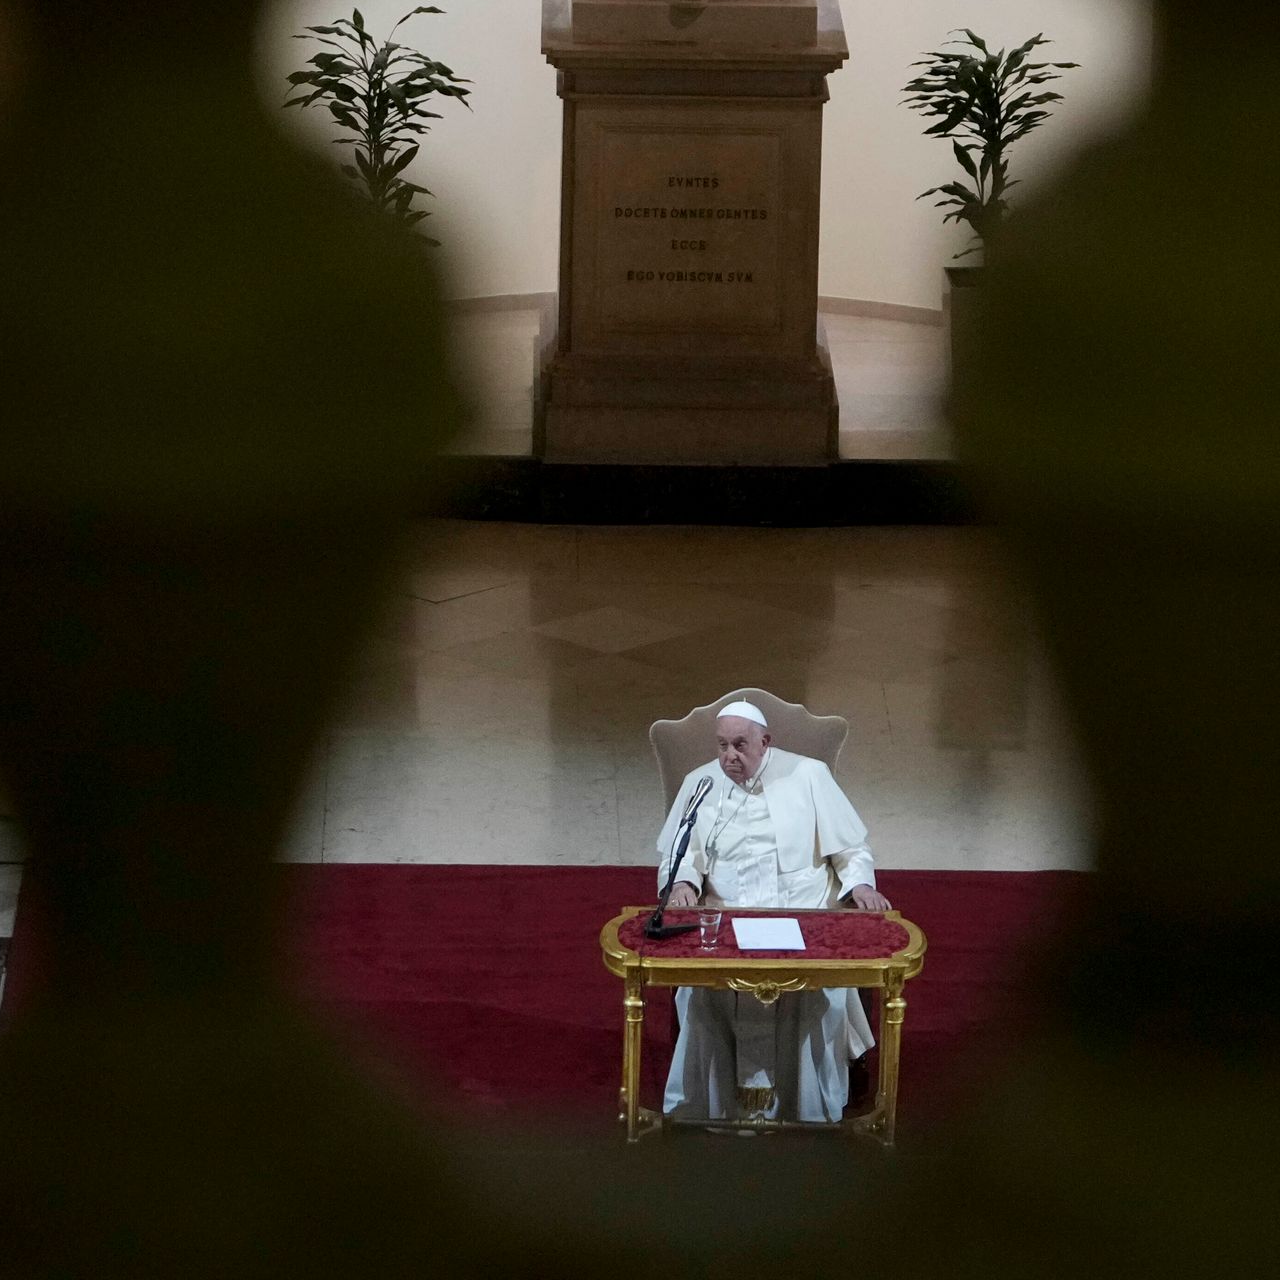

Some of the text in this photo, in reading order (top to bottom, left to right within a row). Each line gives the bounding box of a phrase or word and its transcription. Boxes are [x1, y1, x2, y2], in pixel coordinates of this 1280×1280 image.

[614, 207, 667, 219] DOCETE
[716, 208, 768, 220] GENTES
[671, 239, 707, 251] ECCE
[626, 270, 655, 282] EGO
